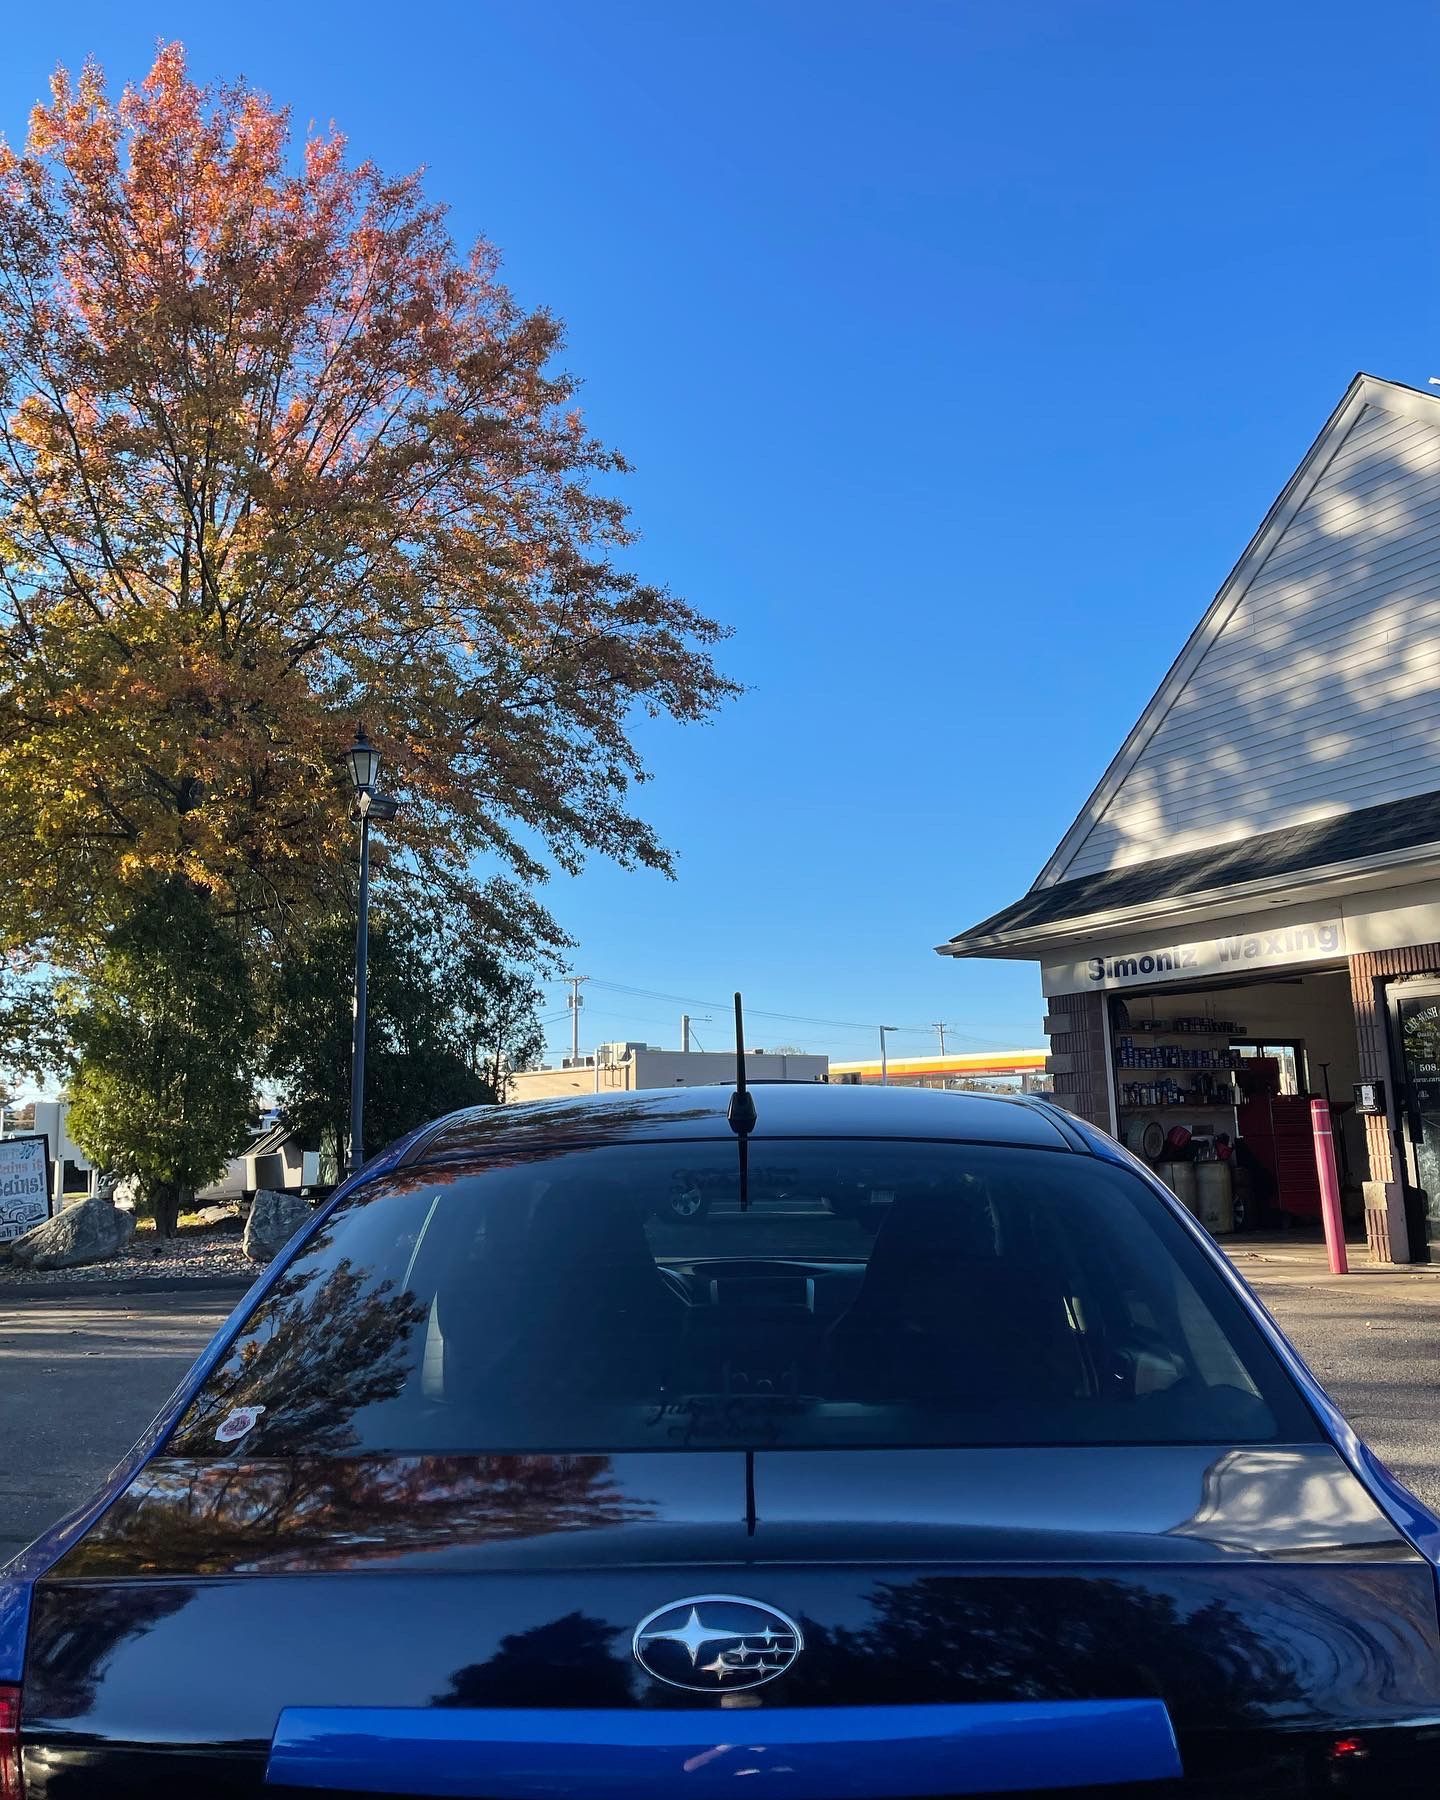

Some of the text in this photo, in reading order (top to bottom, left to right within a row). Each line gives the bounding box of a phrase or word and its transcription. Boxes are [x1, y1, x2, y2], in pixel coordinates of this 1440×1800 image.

[1088, 923, 1339, 981] Simoniz Waxing
[1404, 1006, 1438, 1034] CAR WASH
[0, 1171, 44, 1197] ains!
